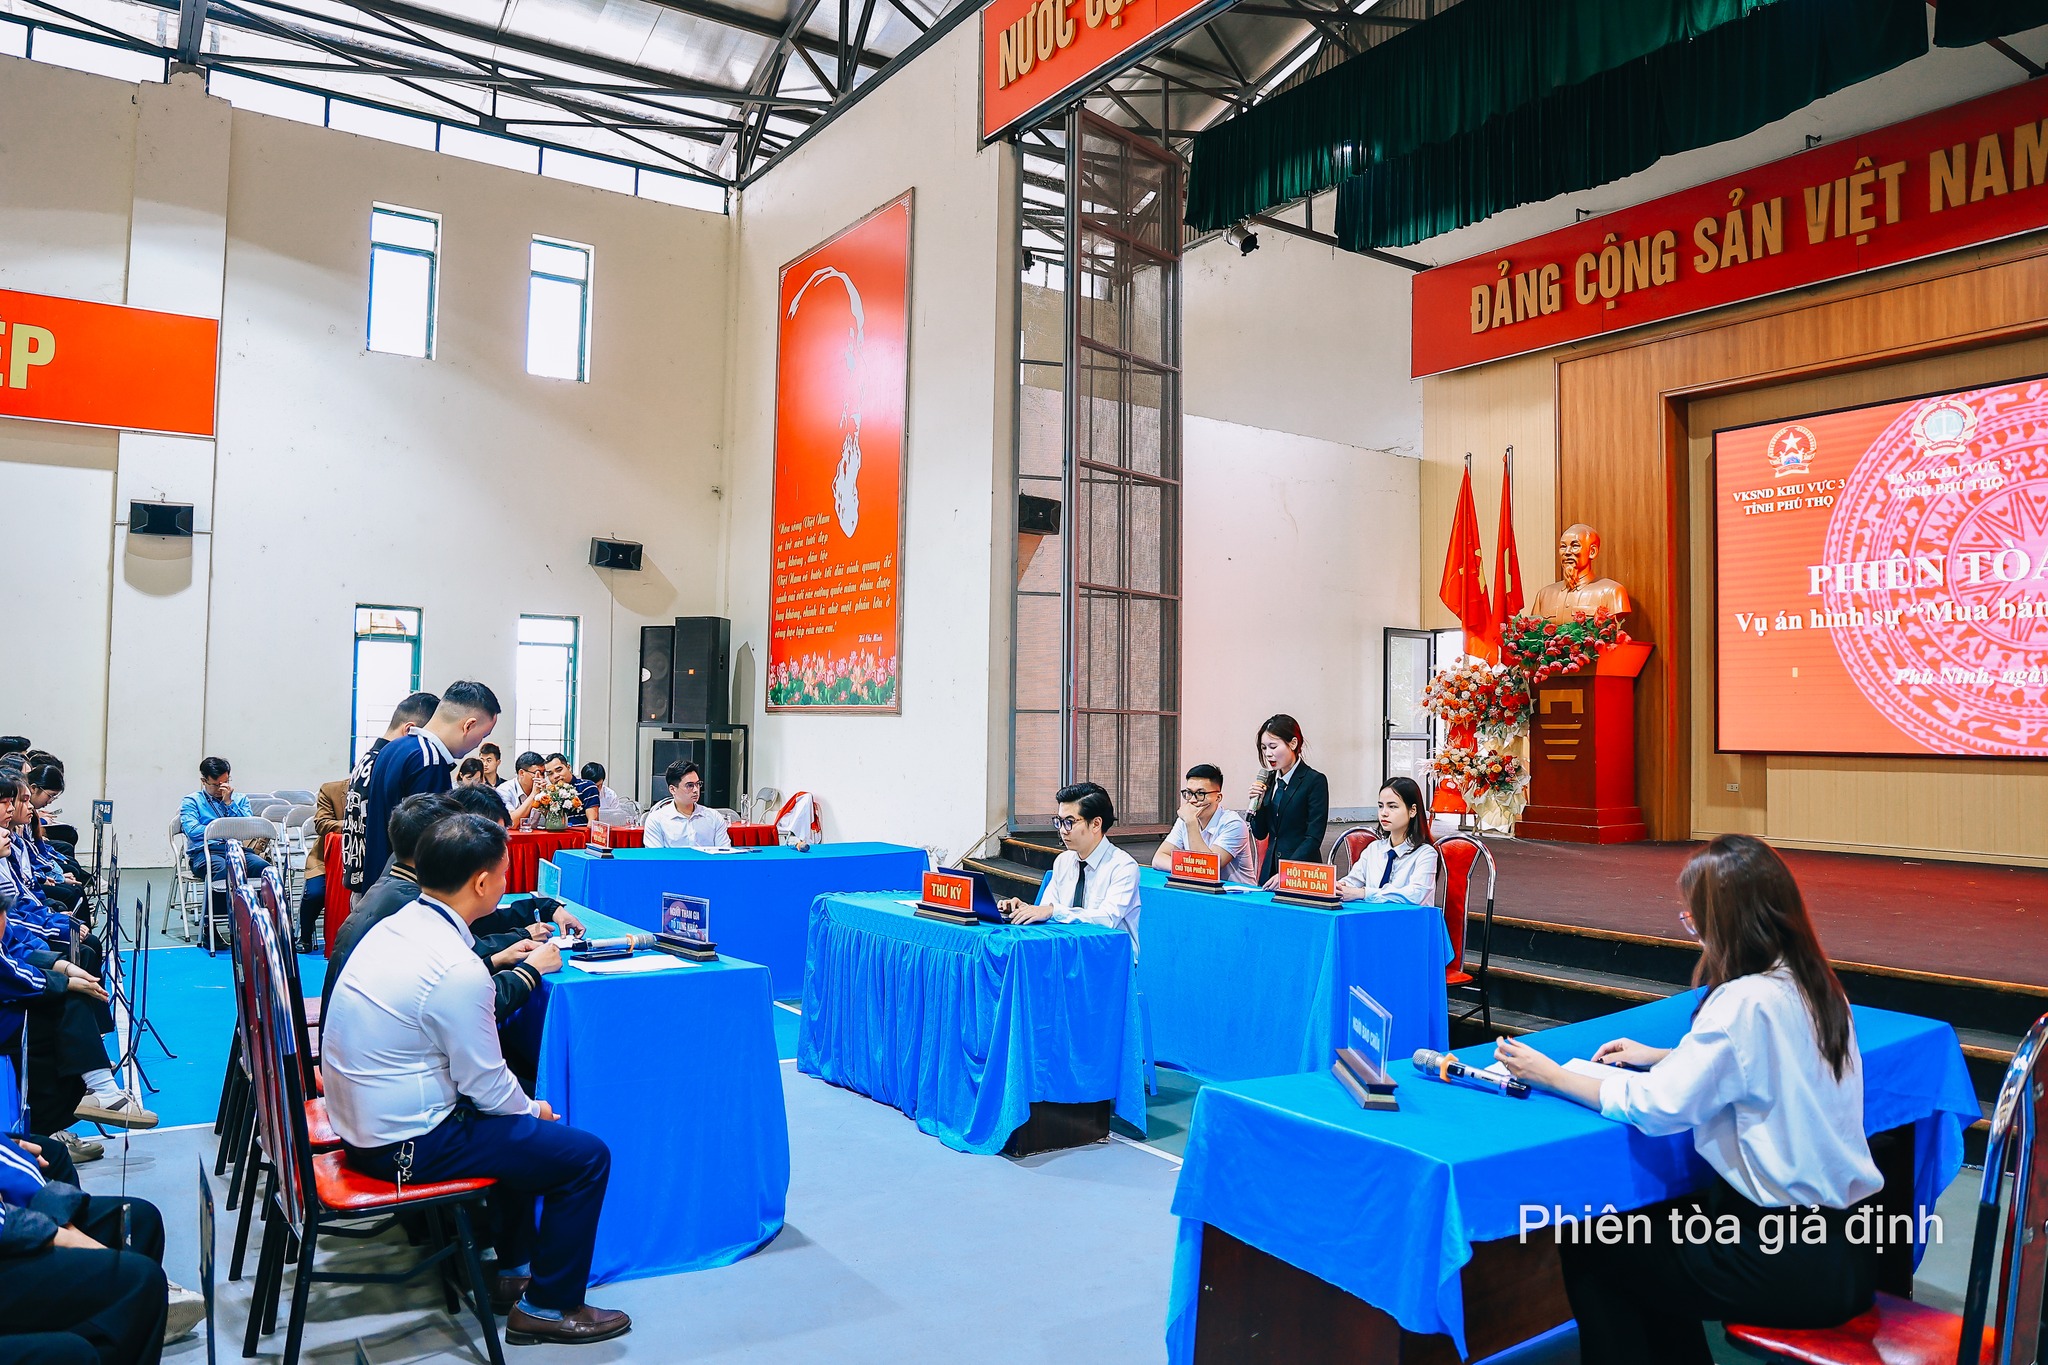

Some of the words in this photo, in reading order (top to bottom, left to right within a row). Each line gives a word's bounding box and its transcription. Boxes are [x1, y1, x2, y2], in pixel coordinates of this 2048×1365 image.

[1471, 260, 1561, 334] ĐẢNG
[1575, 236, 1677, 310] CỘNG
[1694, 187, 1786, 274] SẢN
[1804, 157, 1907, 245] VIỆT
[1929, 119, 2048, 213] NAM
[0, 314, 56, 390] P
[1888, 470, 1927, 485] TAND
[1930, 466, 1963, 479] KHU
[1966, 460, 2000, 476] VỰC
[2003, 459, 2013, 470] 3
[1733, 488, 1774, 502] VKSND
[1777, 484, 1804, 497] KHU
[1807, 479, 1836, 494] VỰC
[1838, 479, 1846, 489] 3
[1935, 479, 1966, 495] PHÚ
[1970, 477, 2004, 490] THỌ
[1744, 502, 1774, 515] TỈNH
[1777, 497, 1802, 511] PHÚ
[1805, 496, 1834, 508] THỌ
[1807, 549, 1947, 596] PHIÊN
[1735, 612, 1768, 637] Vụ
[1775, 610, 1801, 630] án
[1809, 606, 1865, 629] hình
[1873, 609, 1903, 631] sự
[1998, 596, 2048, 620] bán
[1939, 667, 1995, 687] Ninh,
[1286, 867, 1301, 878] HỘI
[1303, 867, 1327, 880] THẨM
[931, 883, 949, 898] THƯ
[950, 883, 962, 900] KÝ
[1286, 878, 1308, 889] NHÂN
[1310, 880, 1328, 892] DÂN
